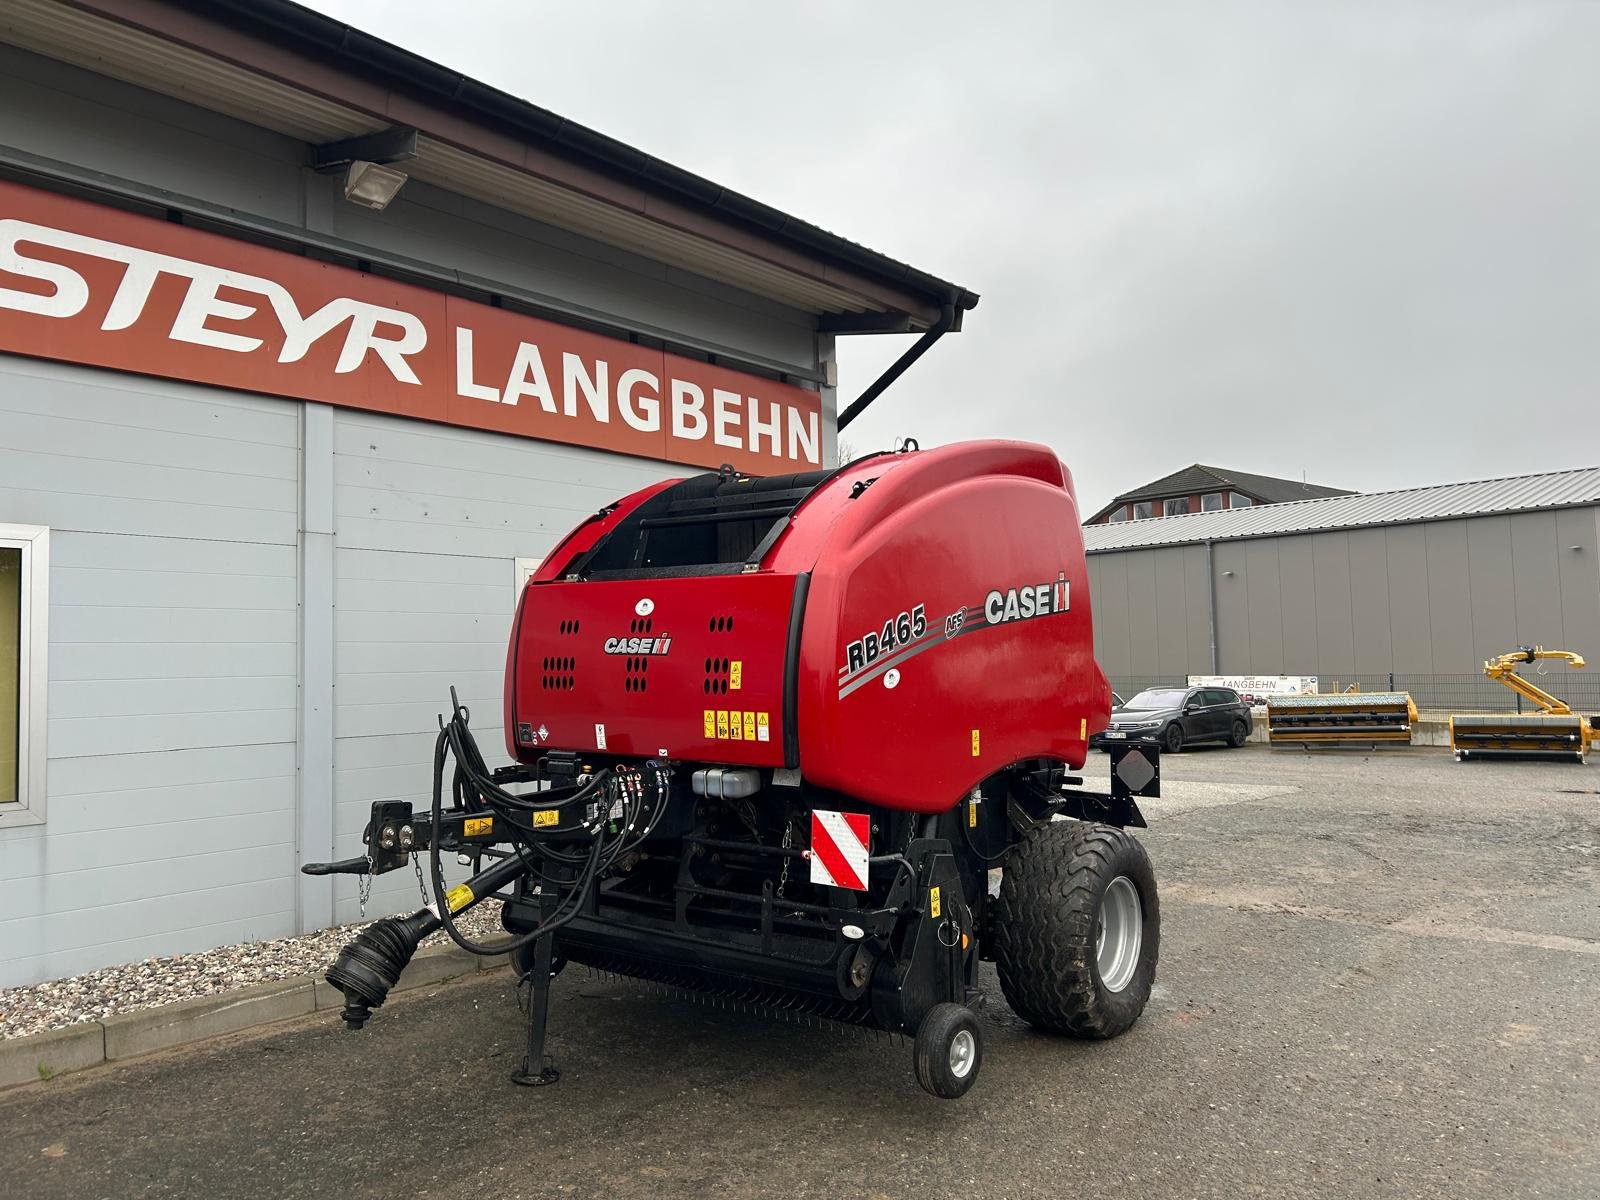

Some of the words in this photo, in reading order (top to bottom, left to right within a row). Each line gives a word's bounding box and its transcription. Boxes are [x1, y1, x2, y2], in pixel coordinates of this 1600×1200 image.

[0, 218, 428, 386] STEYR
[455, 326, 820, 465] LANGBEHN
[983, 584, 1050, 624] CASE
[945, 611, 963, 633] AFS
[604, 637, 653, 654] CASE
[846, 603, 928, 675] RB465
[1222, 680, 1277, 689] LANGBEHN
